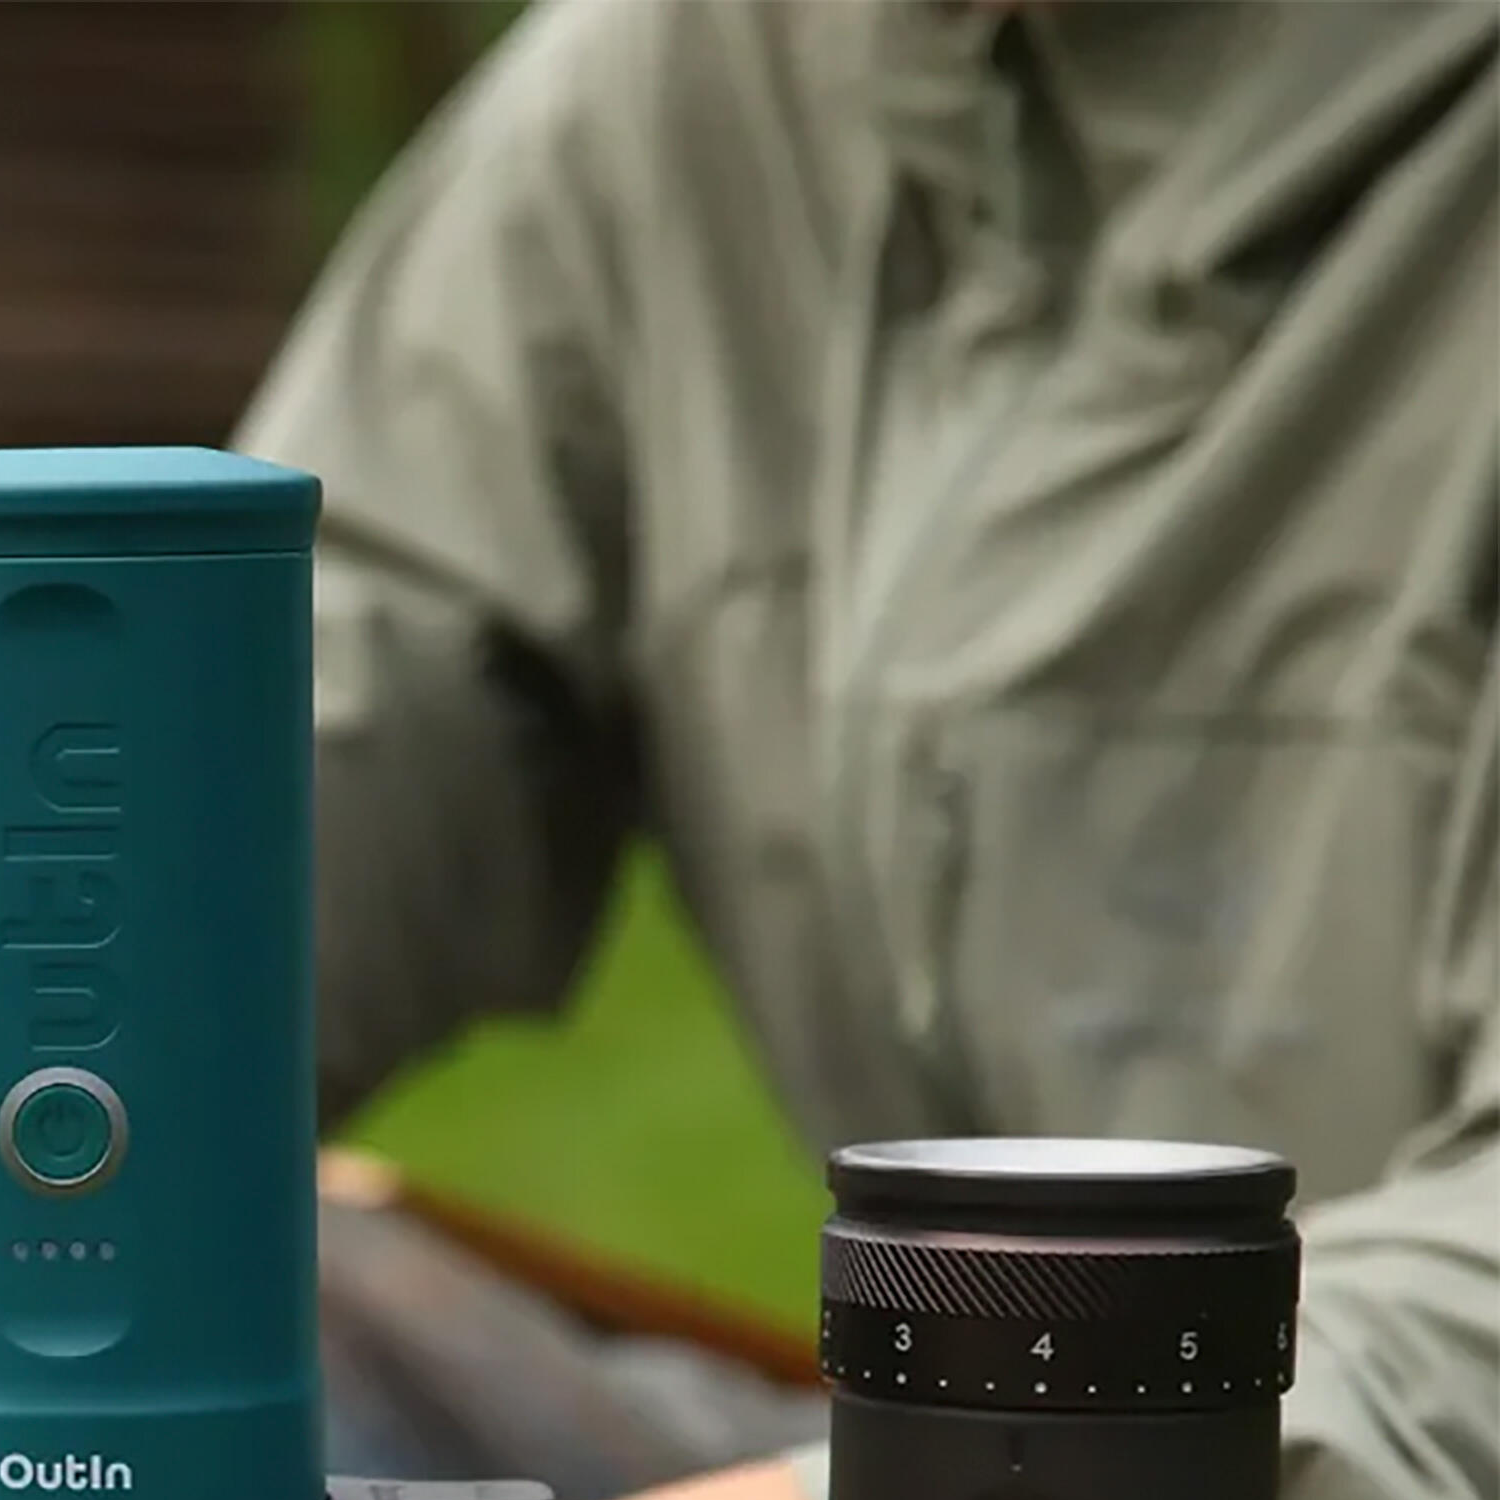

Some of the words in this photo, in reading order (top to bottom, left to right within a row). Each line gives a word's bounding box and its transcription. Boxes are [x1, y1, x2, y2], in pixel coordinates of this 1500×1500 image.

[894, 1322, 913, 1352] 3
[1029, 1332, 1055, 1361] 4
[1179, 1330, 1199, 1361] 5
